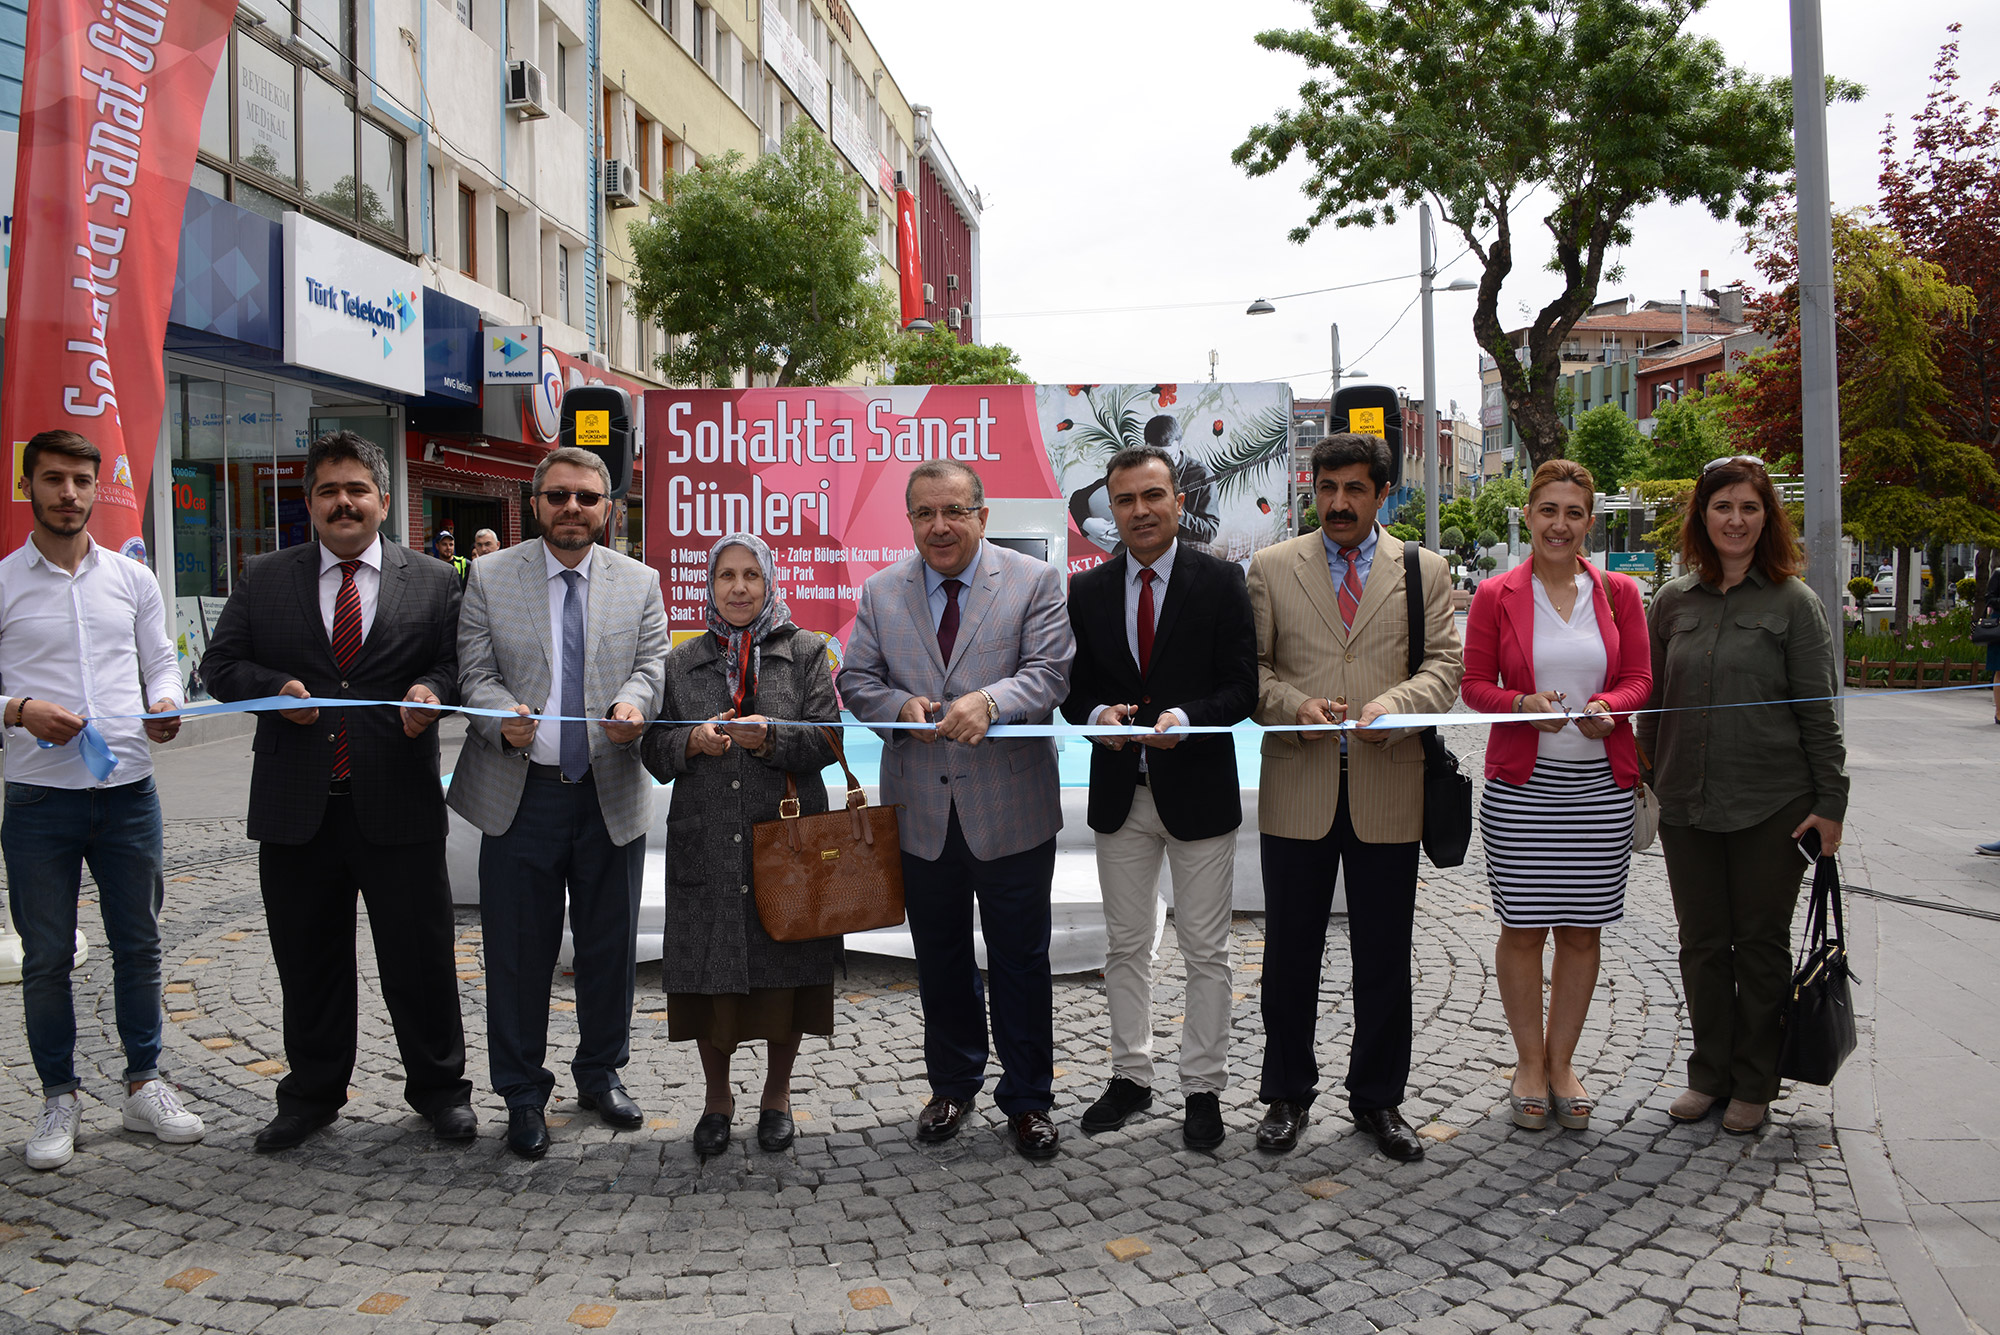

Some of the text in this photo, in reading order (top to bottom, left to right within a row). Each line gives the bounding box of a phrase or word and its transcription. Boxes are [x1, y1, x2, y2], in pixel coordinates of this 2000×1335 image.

[306, 277, 395, 330] Türk Telekom
[444, 376, 456, 389] MVG
[488, 370, 534, 378] Türk Telekom
[668, 400, 857, 466] Sokakta
[867, 398, 1000, 462] Sanat
[668, 474, 829, 537] Günleri
[671, 548, 707, 565] 8 Mayıs
[787, 547, 812, 562] Zafer
[814, 547, 849, 564] Bölgesi
[851, 547, 879, 562] Kazım
[671, 566, 707, 583] 9 Mayıs
[793, 566, 814, 581] Park
[671, 585, 708, 602] 10 Mayı
[796, 584, 835, 600] Mevlana
[837, 584, 862, 601] Meyd
[670, 606, 695, 620] Saat:
